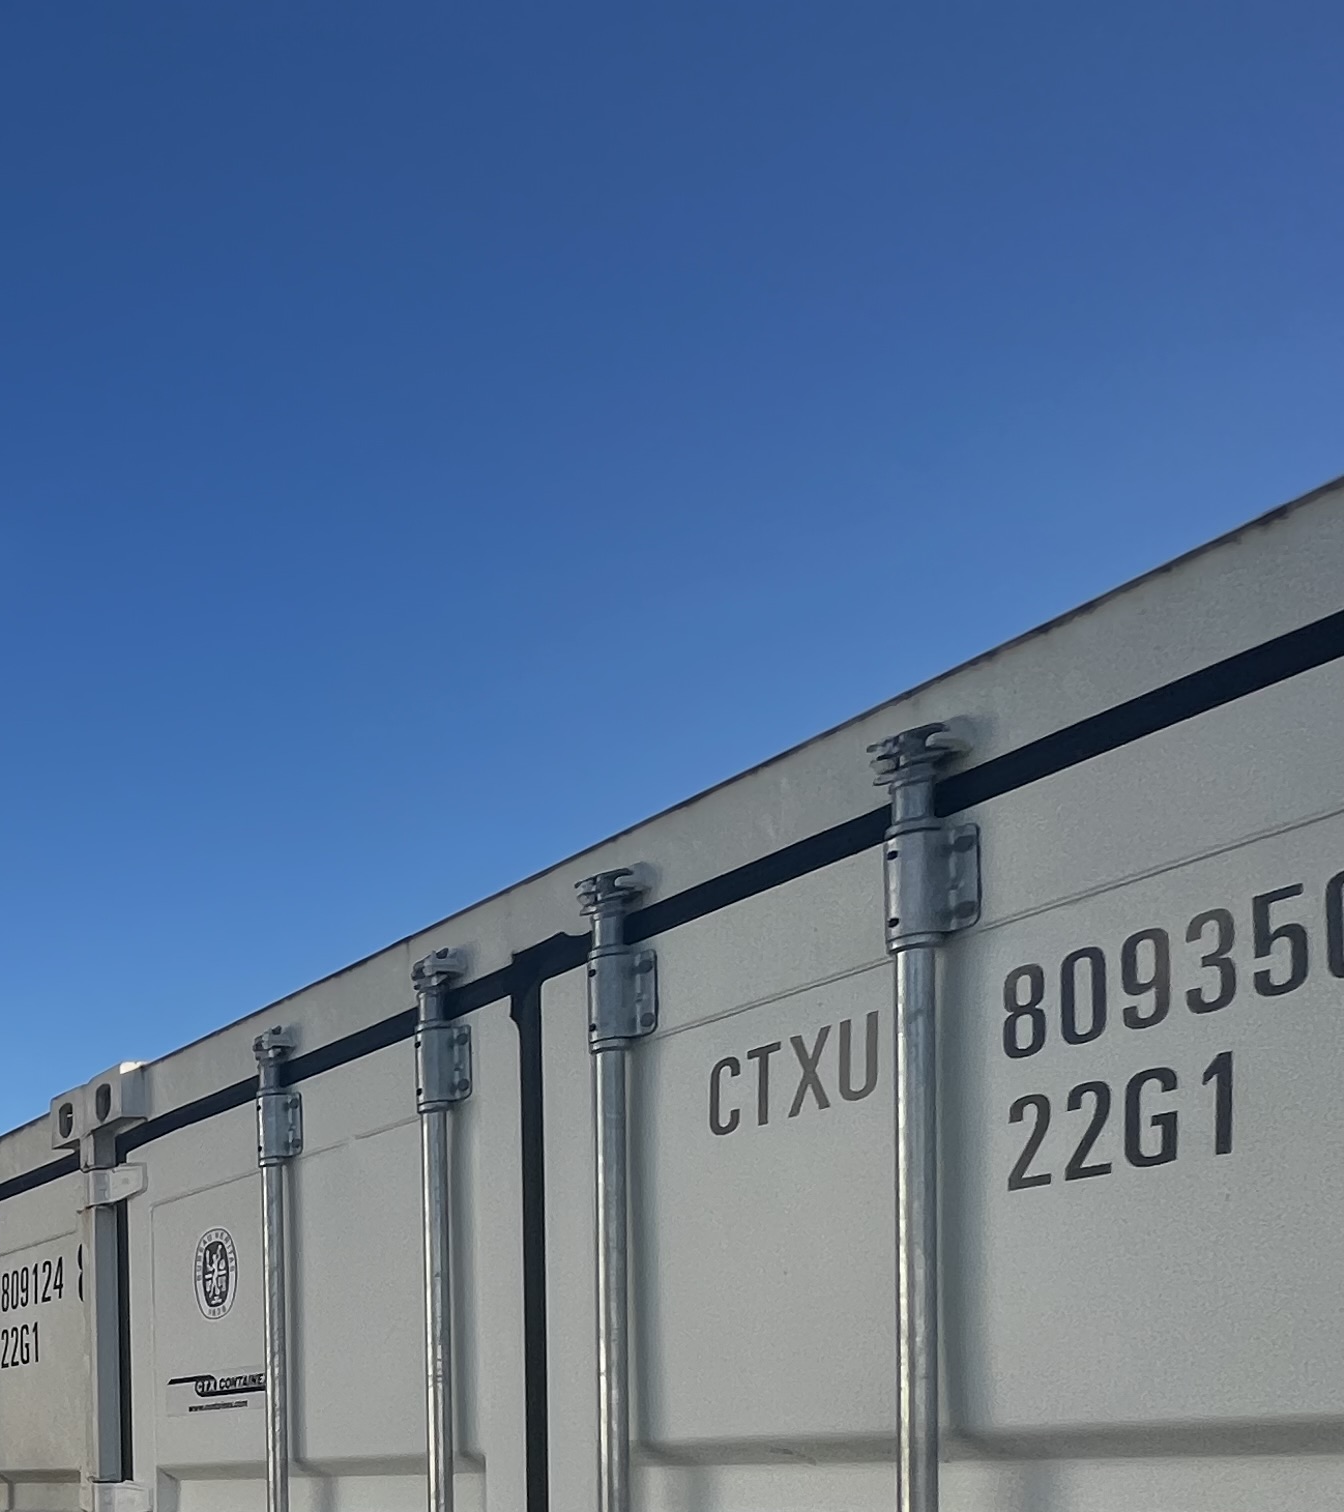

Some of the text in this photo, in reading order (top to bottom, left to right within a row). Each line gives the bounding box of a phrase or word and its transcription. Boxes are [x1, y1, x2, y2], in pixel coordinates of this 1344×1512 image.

[708, 1010, 880, 1138] CTXU
[1007, 1050, 1234, 1191] 22G1
[1, 1256, 64, 1313] 809124
[0, 1321, 40, 1369] 22G1
